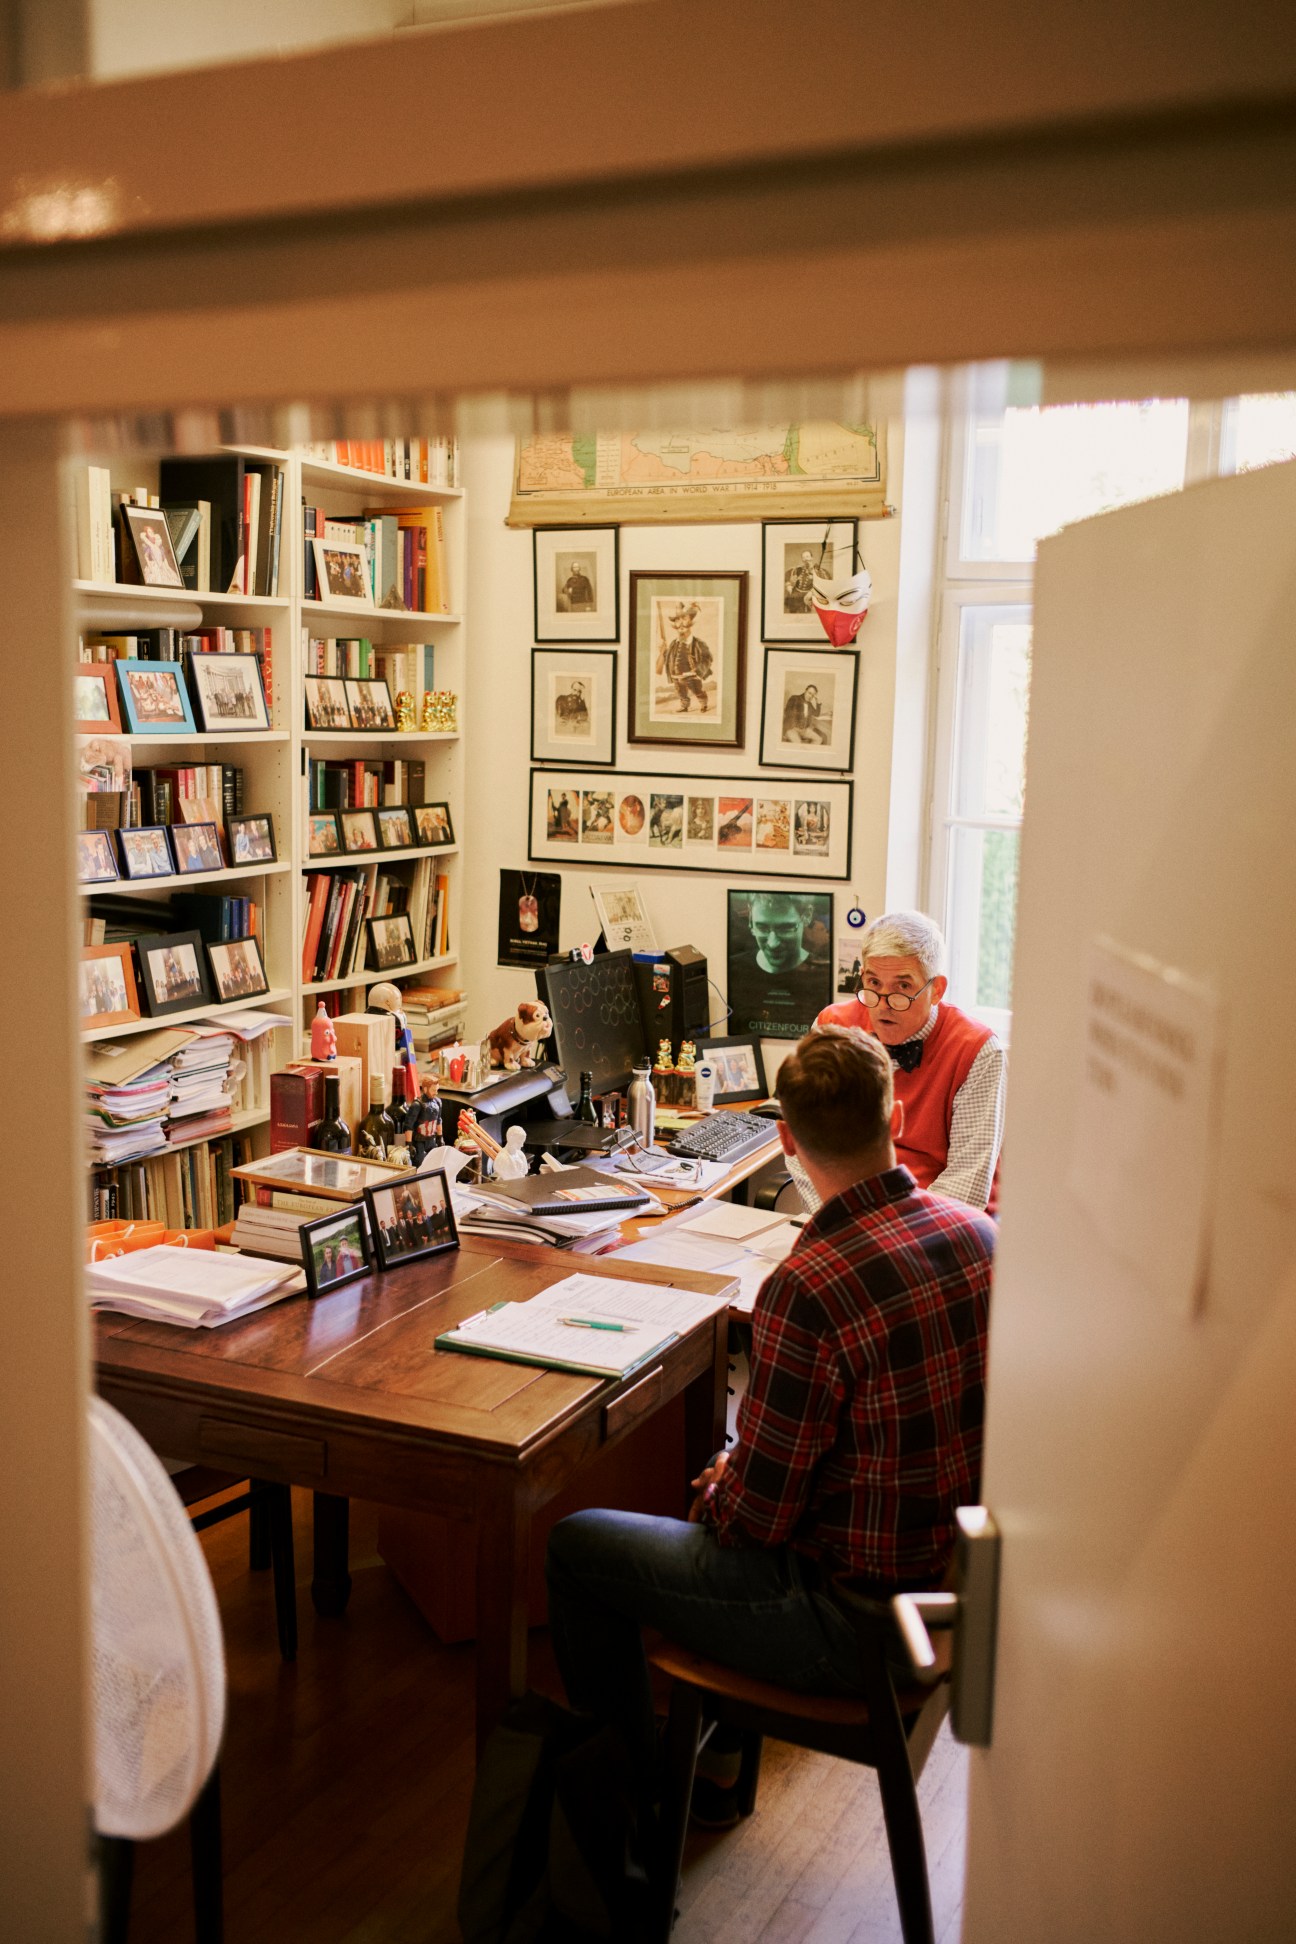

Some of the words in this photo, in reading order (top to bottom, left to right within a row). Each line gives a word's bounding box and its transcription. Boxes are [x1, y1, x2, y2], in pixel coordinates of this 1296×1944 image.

[606, 488, 643, 497] EUROPEAN
[682, 486, 707, 494] WORLD
[265, 647, 273, 696] ITALY
[748, 1021, 809, 1033] CITIZENFOUR
[291, 1201, 324, 1212] EUROPEAN
